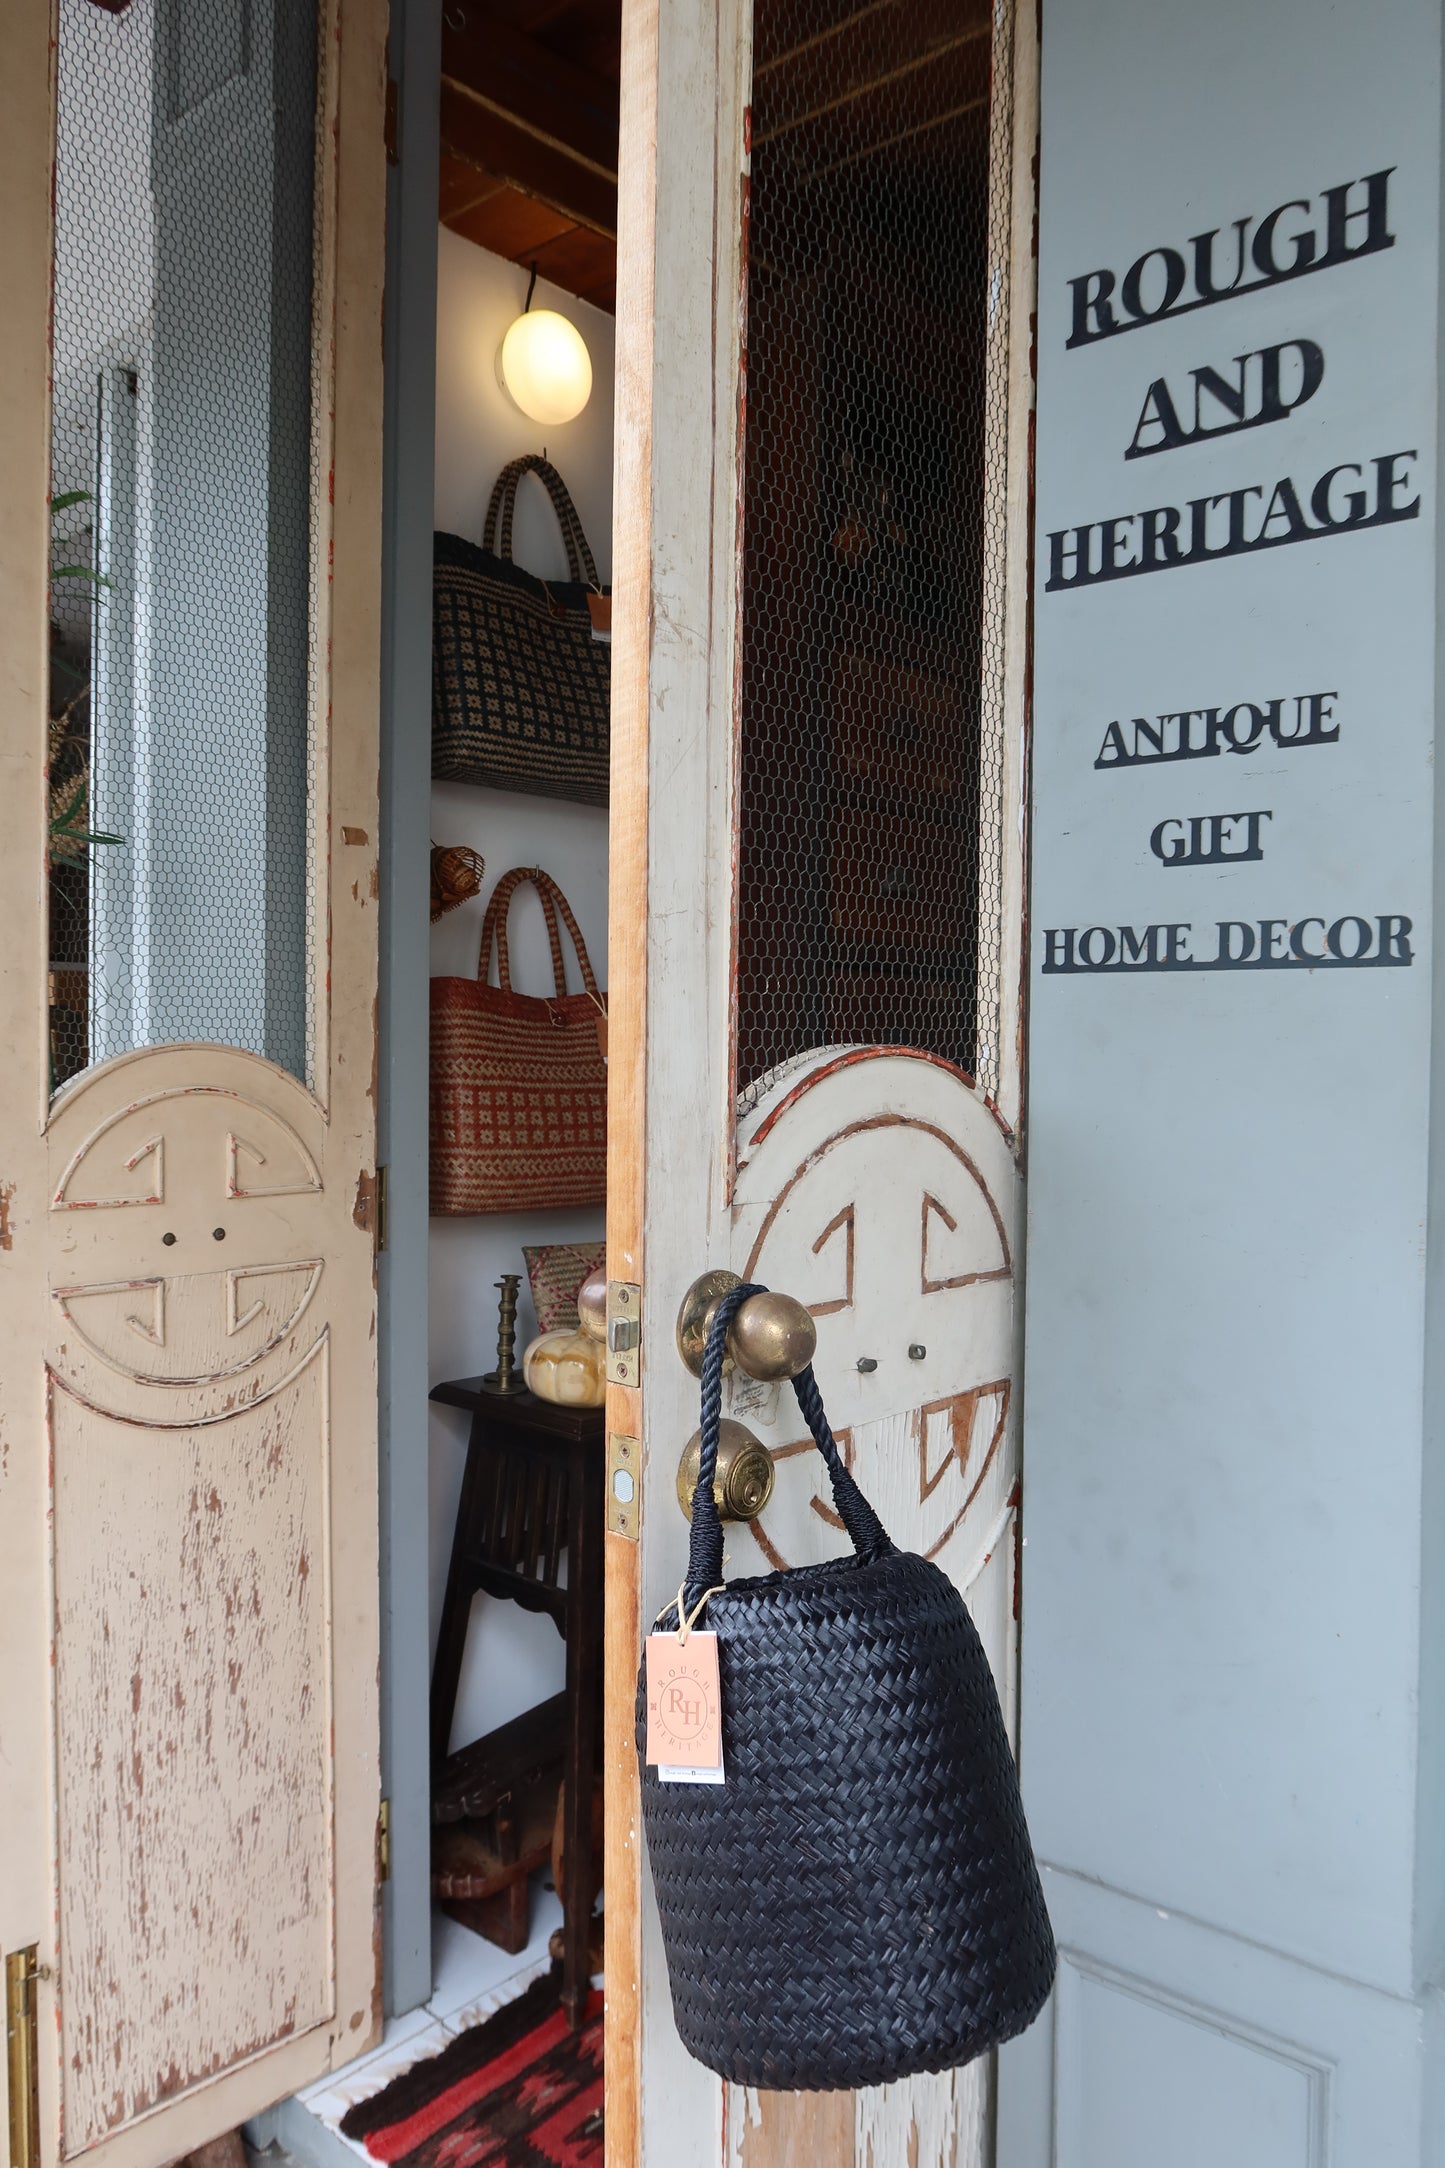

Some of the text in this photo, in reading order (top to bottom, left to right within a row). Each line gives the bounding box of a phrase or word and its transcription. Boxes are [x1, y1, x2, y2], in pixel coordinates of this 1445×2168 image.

[1066, 166, 1398, 350] ROUGH
[1124, 339, 1325, 460] AND
[1045, 450, 1421, 592] HERITAGE
[1094, 691, 1340, 769] ANTIQUE
[1150, 810, 1272, 867] GIFT
[1042, 915, 1415, 974] HOME DECOR
[658, 1666, 710, 1690] ROUGH
[668, 1688, 701, 1725] RH
[655, 1720, 713, 1751] HERITAGE
